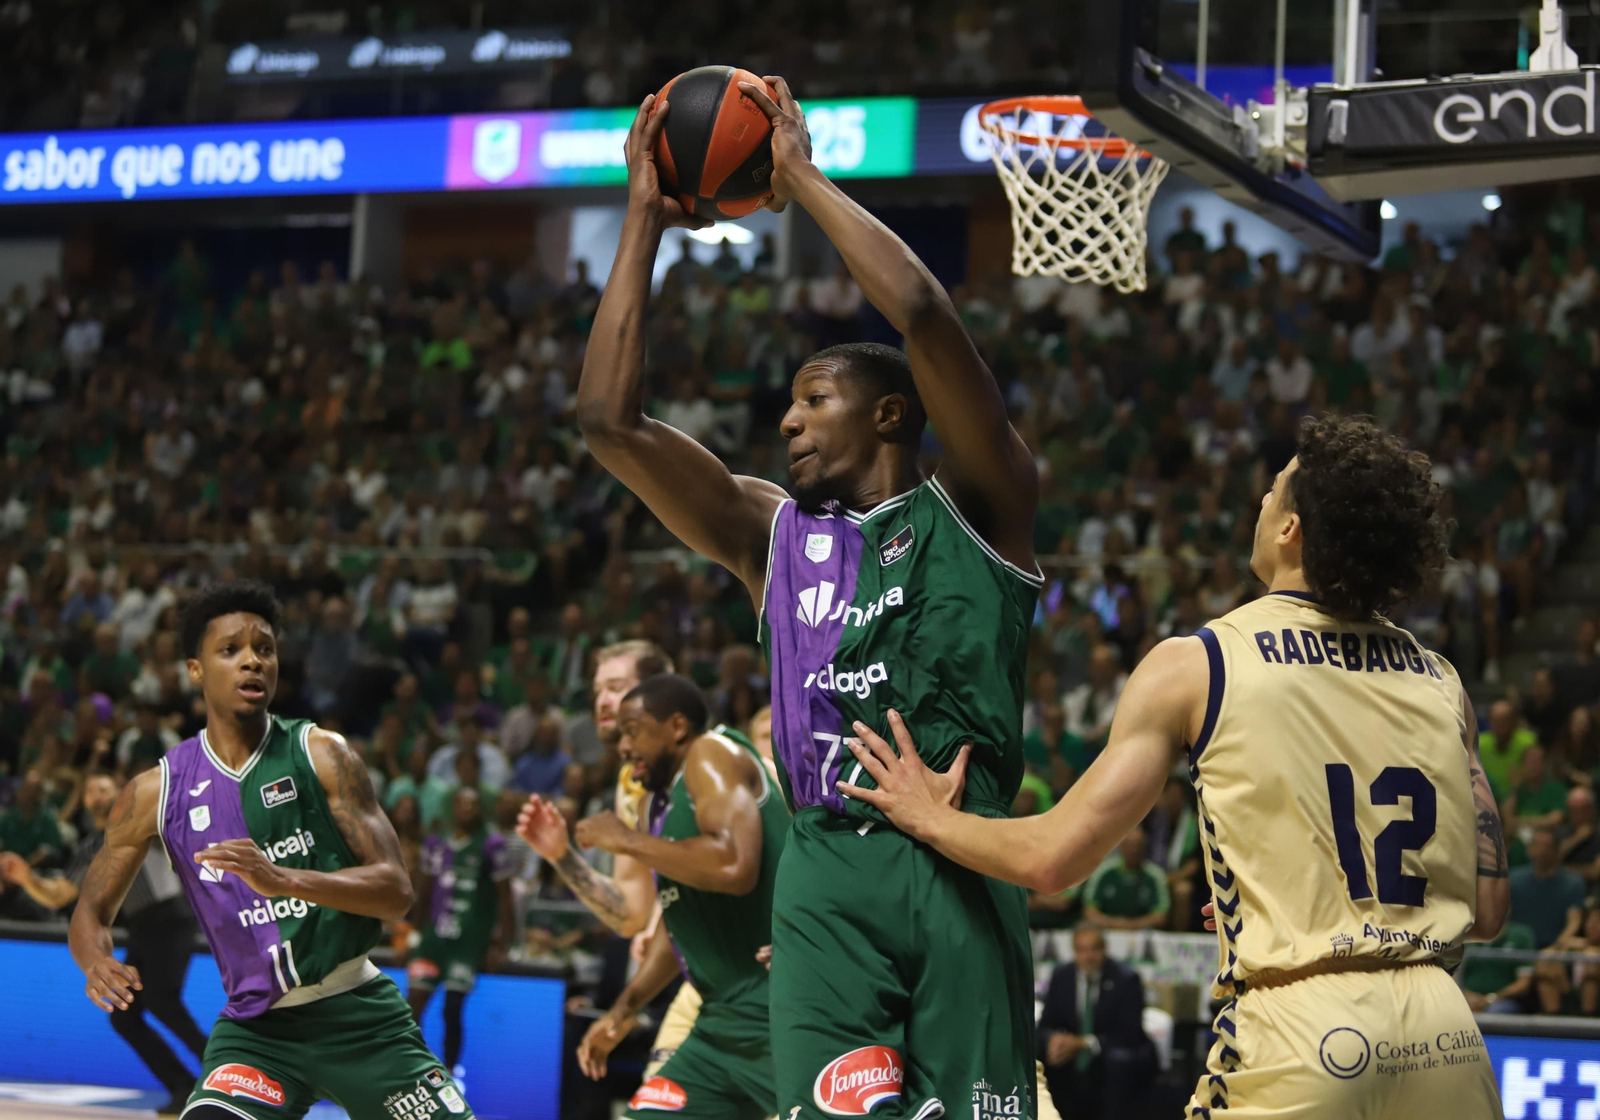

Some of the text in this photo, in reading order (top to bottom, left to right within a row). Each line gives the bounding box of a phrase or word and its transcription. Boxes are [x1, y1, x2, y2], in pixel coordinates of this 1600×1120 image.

[806, 107, 867, 170] 25
[4, 136, 346, 199] sabor que nos une
[883, 545, 898, 557] liga
[1324, 763, 1437, 908] 12
[267, 940, 302, 993] 11
[1375, 1029, 1484, 1060] Costa Cálida
[1375, 1051, 1481, 1078] Región de Murcia
[207, 1066, 282, 1102] famadesa
[393, 1079, 432, 1116] má
[972, 1091, 980, 1101] a
[981, 1085, 1022, 1115] má
